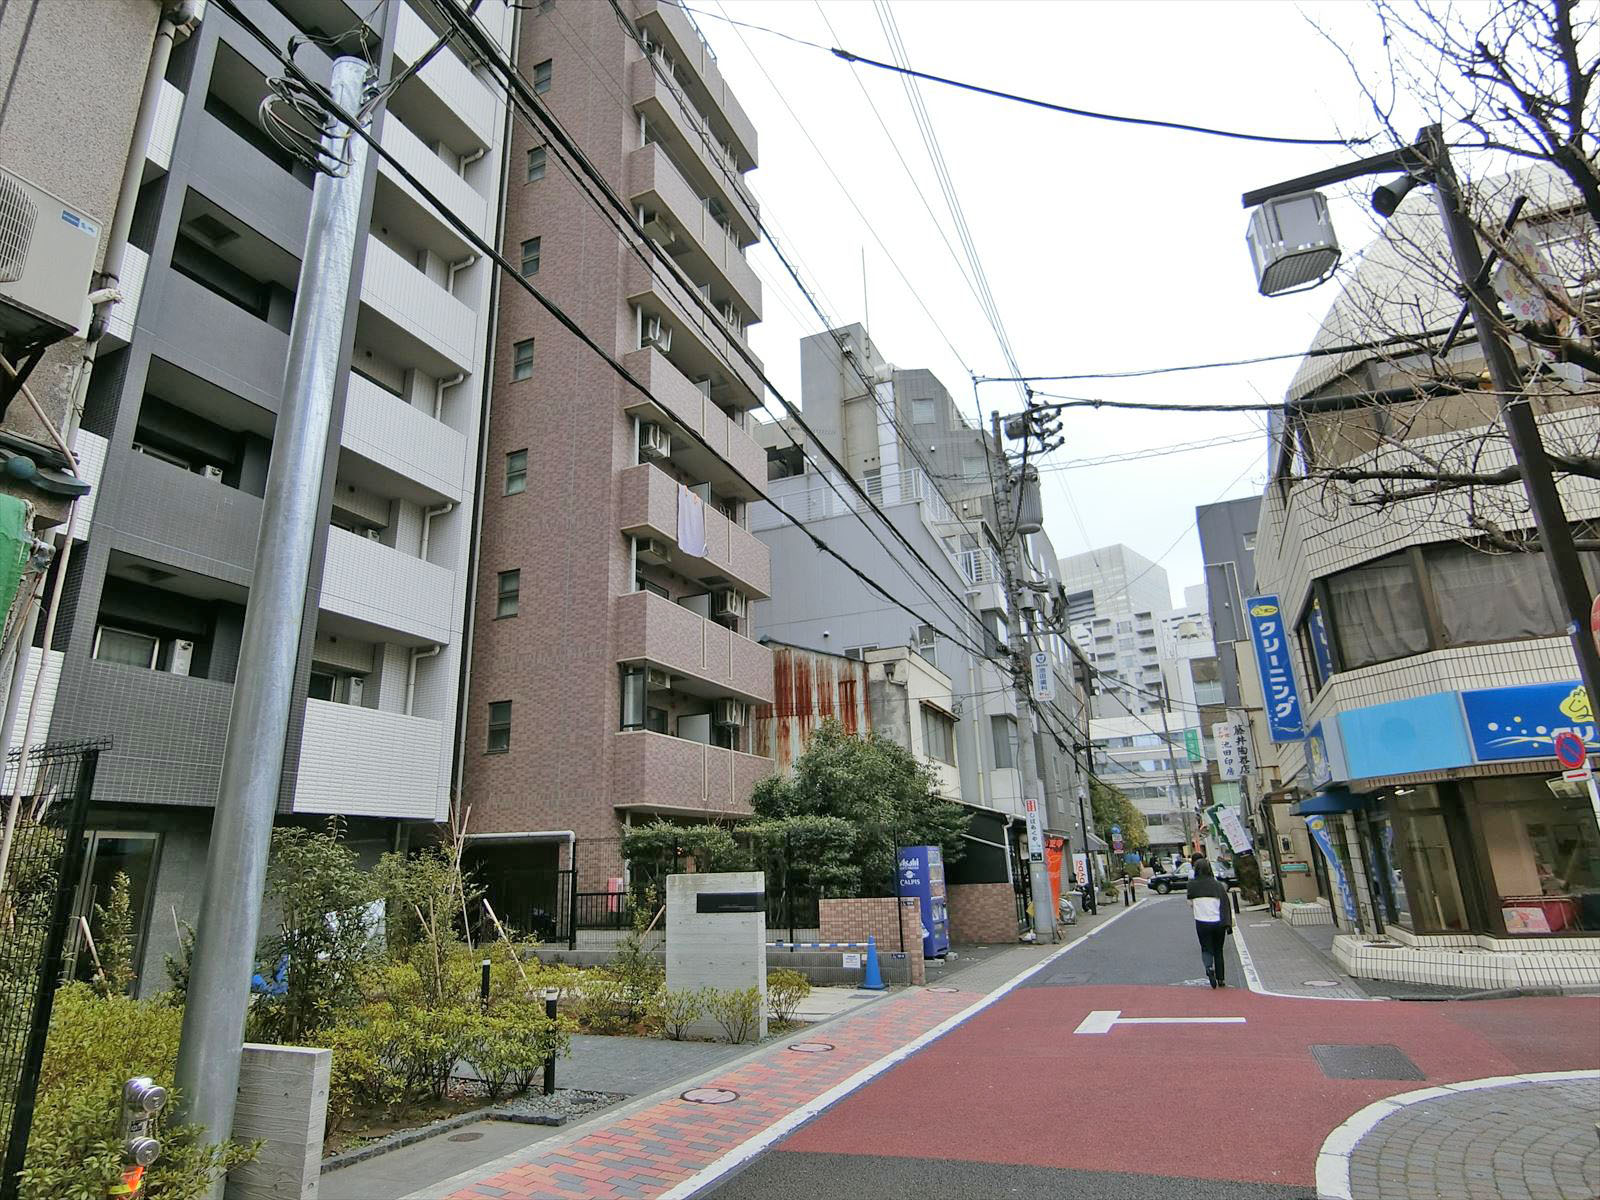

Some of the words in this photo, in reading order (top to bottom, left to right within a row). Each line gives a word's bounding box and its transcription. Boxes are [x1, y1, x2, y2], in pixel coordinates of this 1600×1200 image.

[1259, 621, 1297, 718] クリーニング
[899, 857, 920, 868] Asahi
[899, 878, 921, 887] CALPIS
